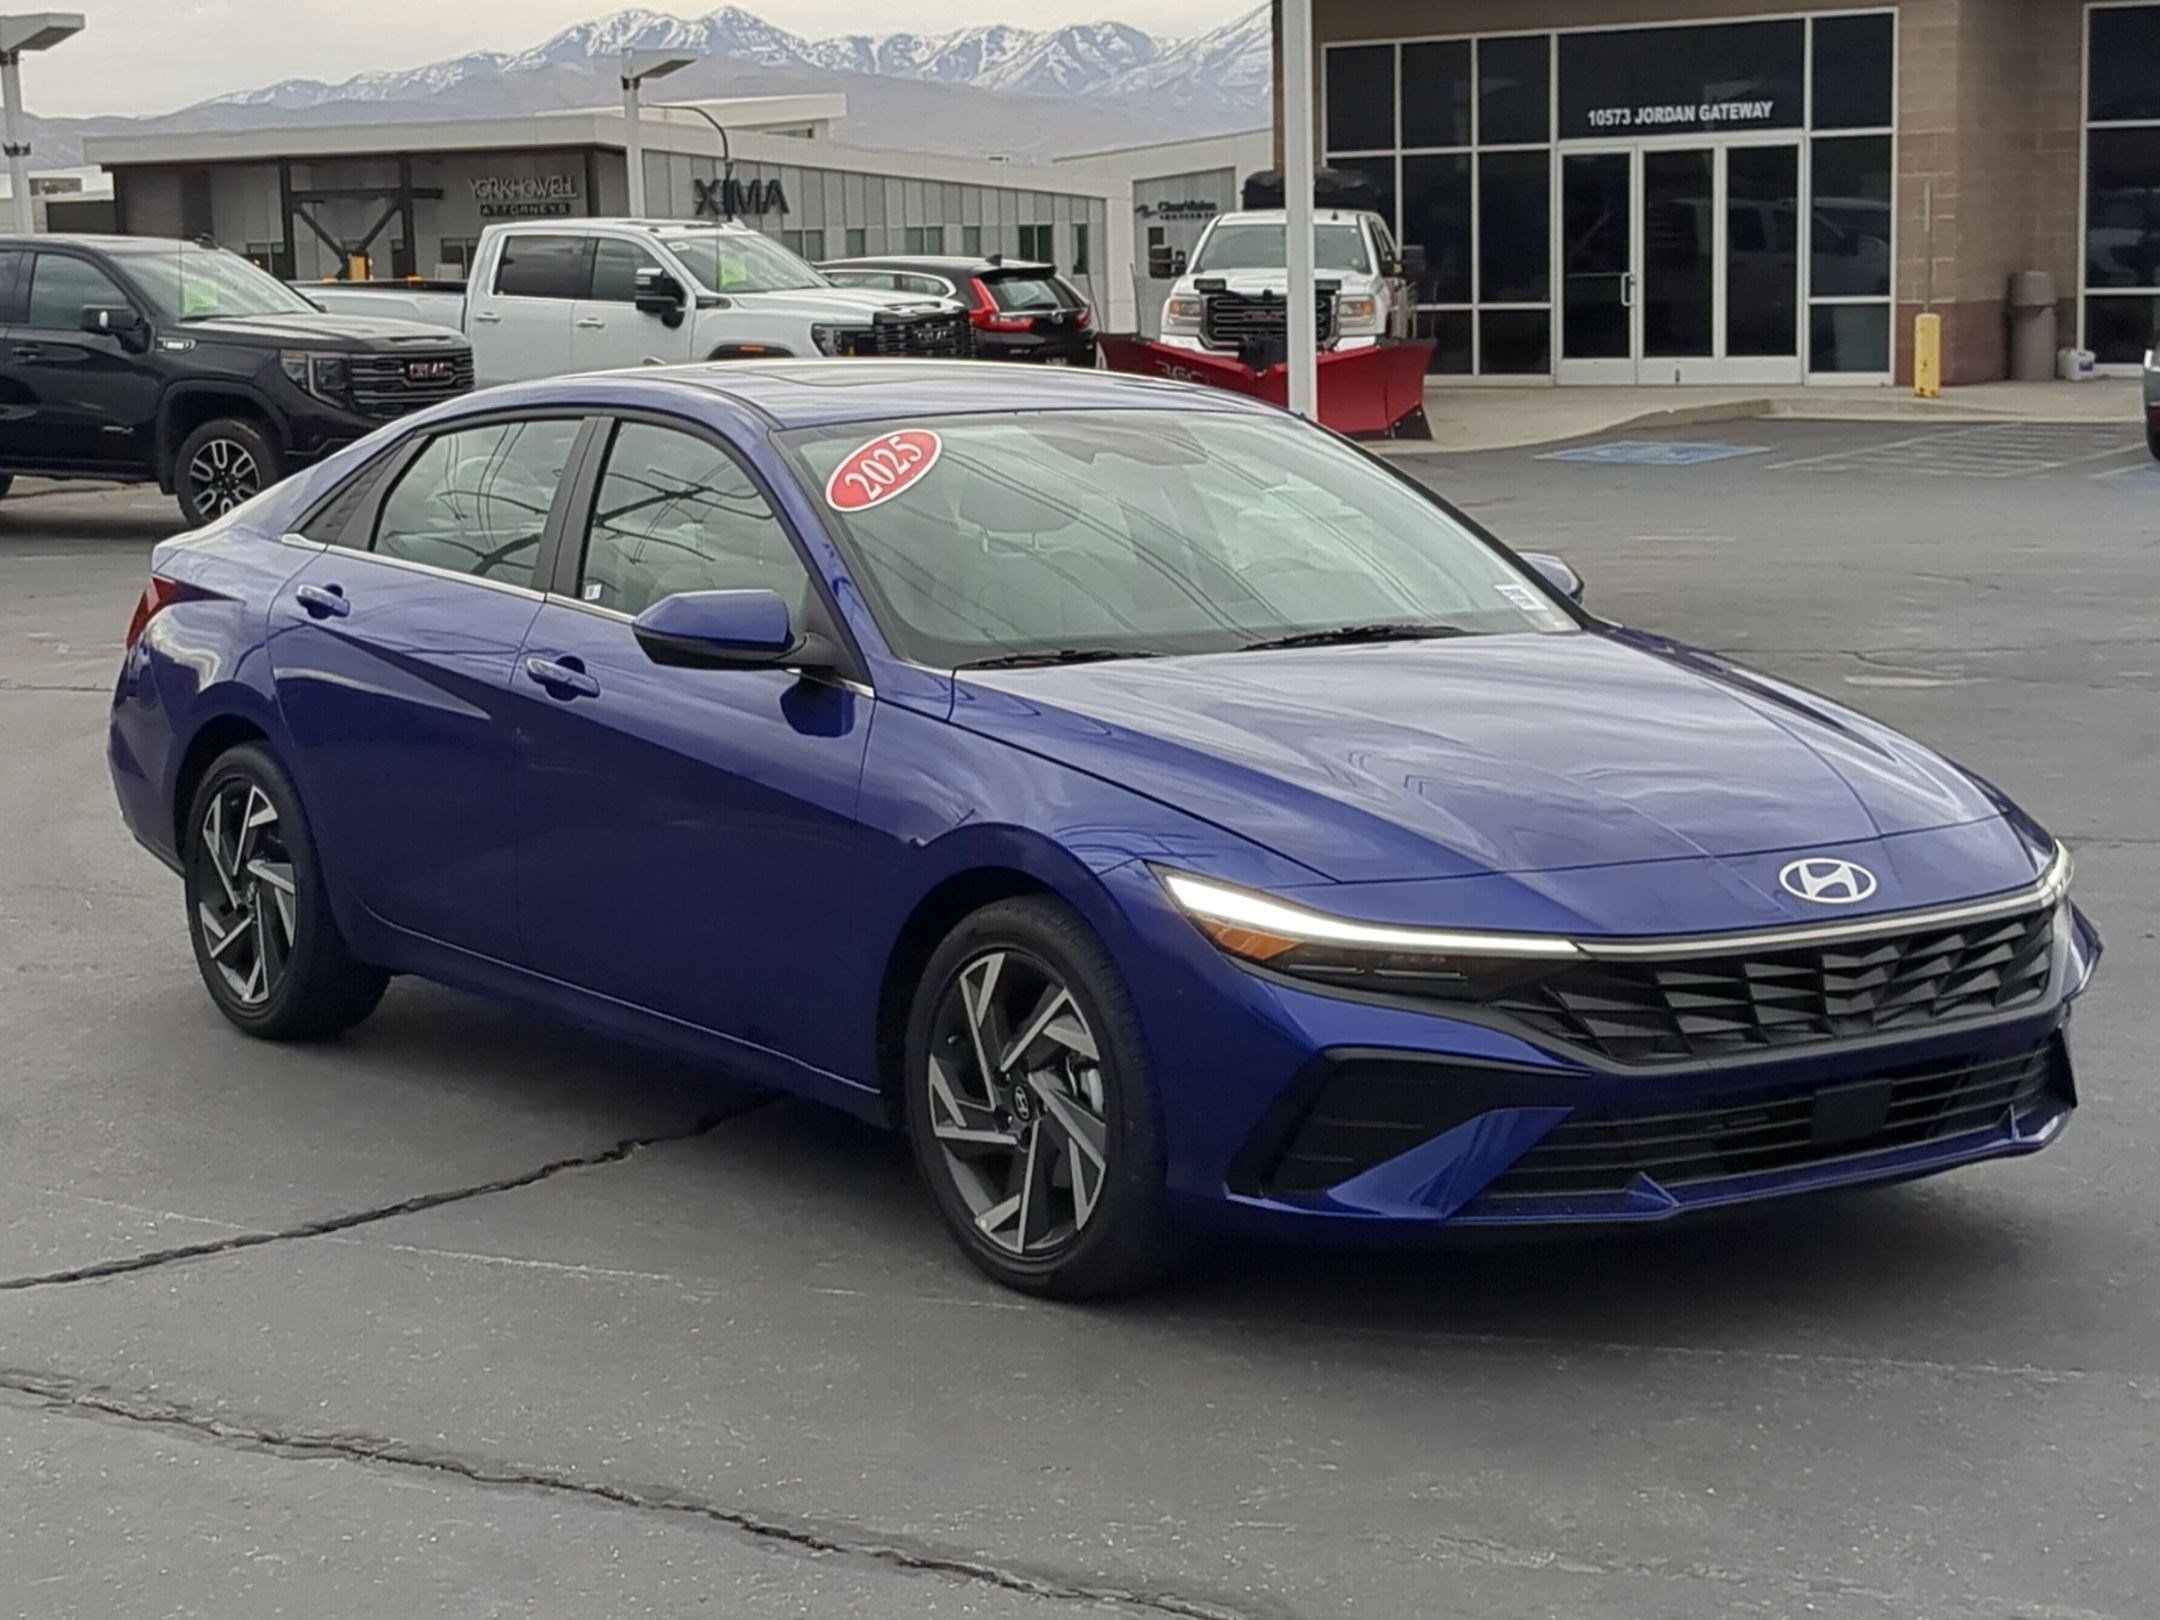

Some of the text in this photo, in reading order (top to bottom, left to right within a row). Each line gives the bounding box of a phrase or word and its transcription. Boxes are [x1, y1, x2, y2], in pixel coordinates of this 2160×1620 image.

[1588, 101, 1773, 127] 10573 JORDAN GATEWAY
[482, 203, 567, 216] ATTORNEYS
[694, 178, 790, 215] XIMA
[844, 435, 922, 501] 2025
